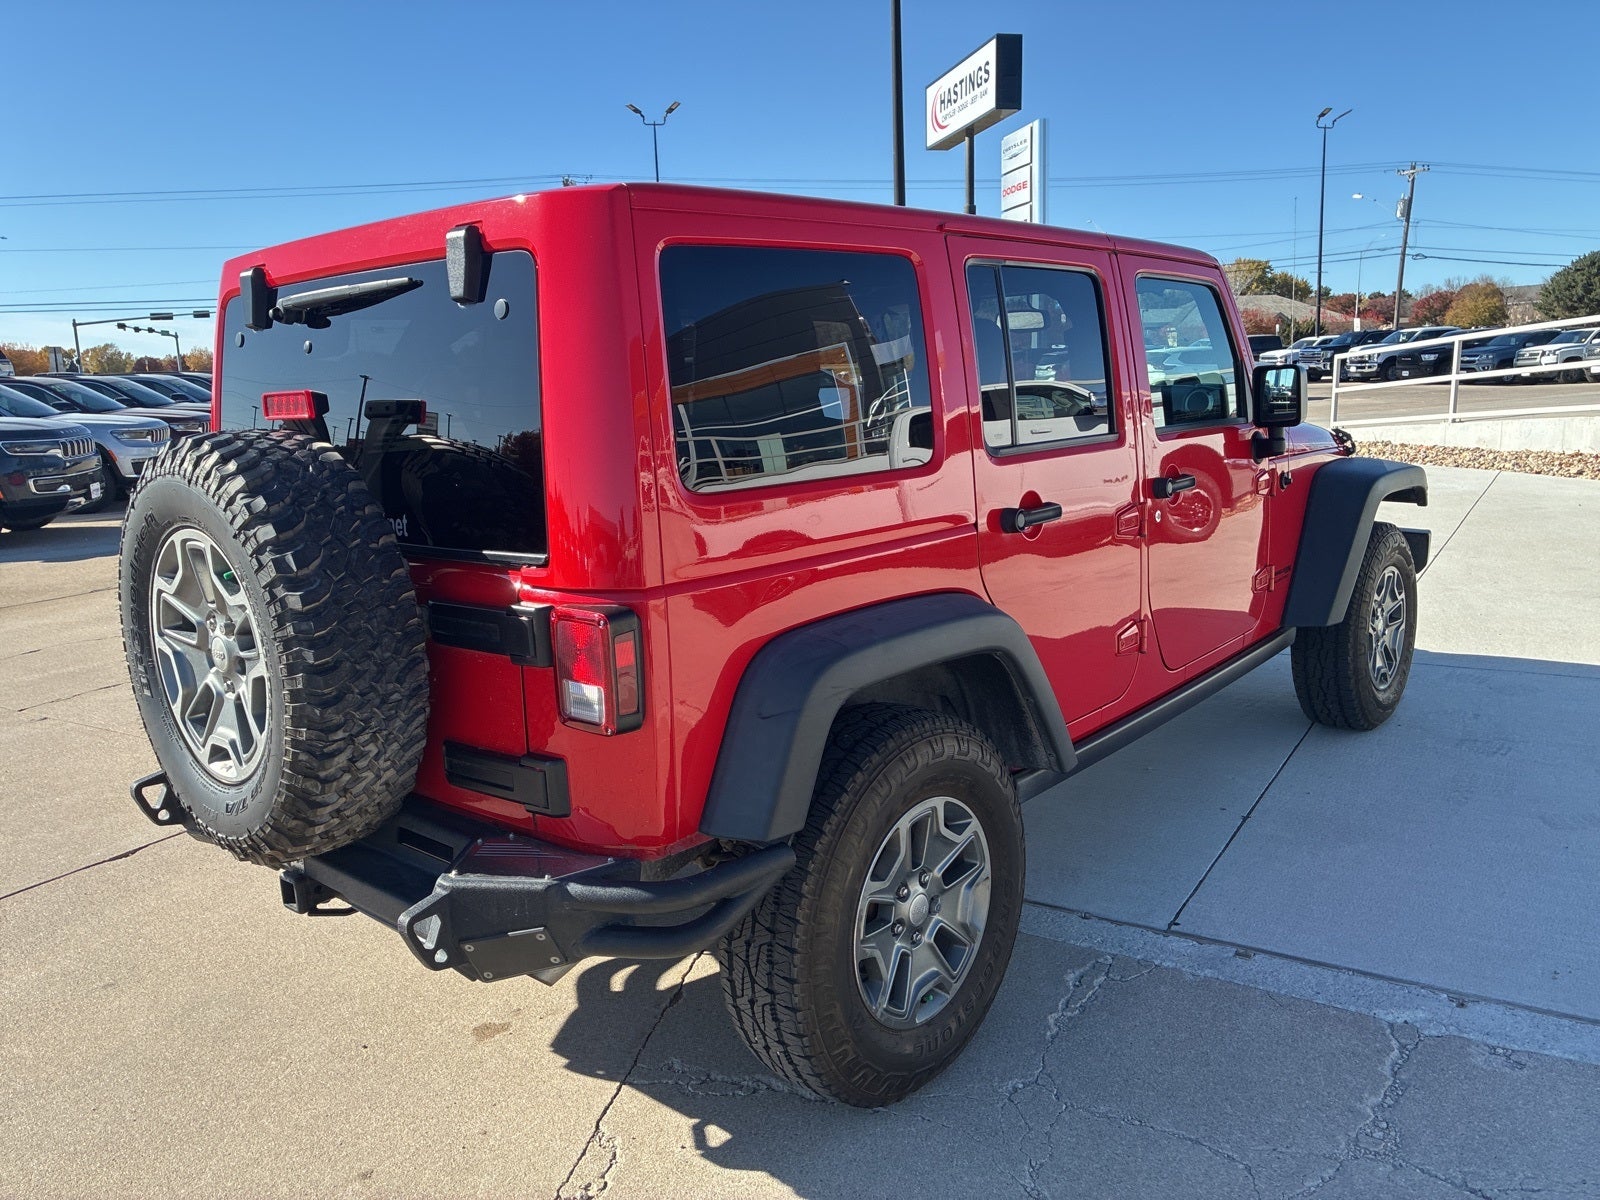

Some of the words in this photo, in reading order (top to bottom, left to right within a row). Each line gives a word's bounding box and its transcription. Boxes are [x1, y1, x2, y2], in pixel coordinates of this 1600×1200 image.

[940, 60, 990, 113] HASTINGS
[1002, 138, 1028, 154] CHRYSLER
[1002, 180, 1028, 198] DODGE
